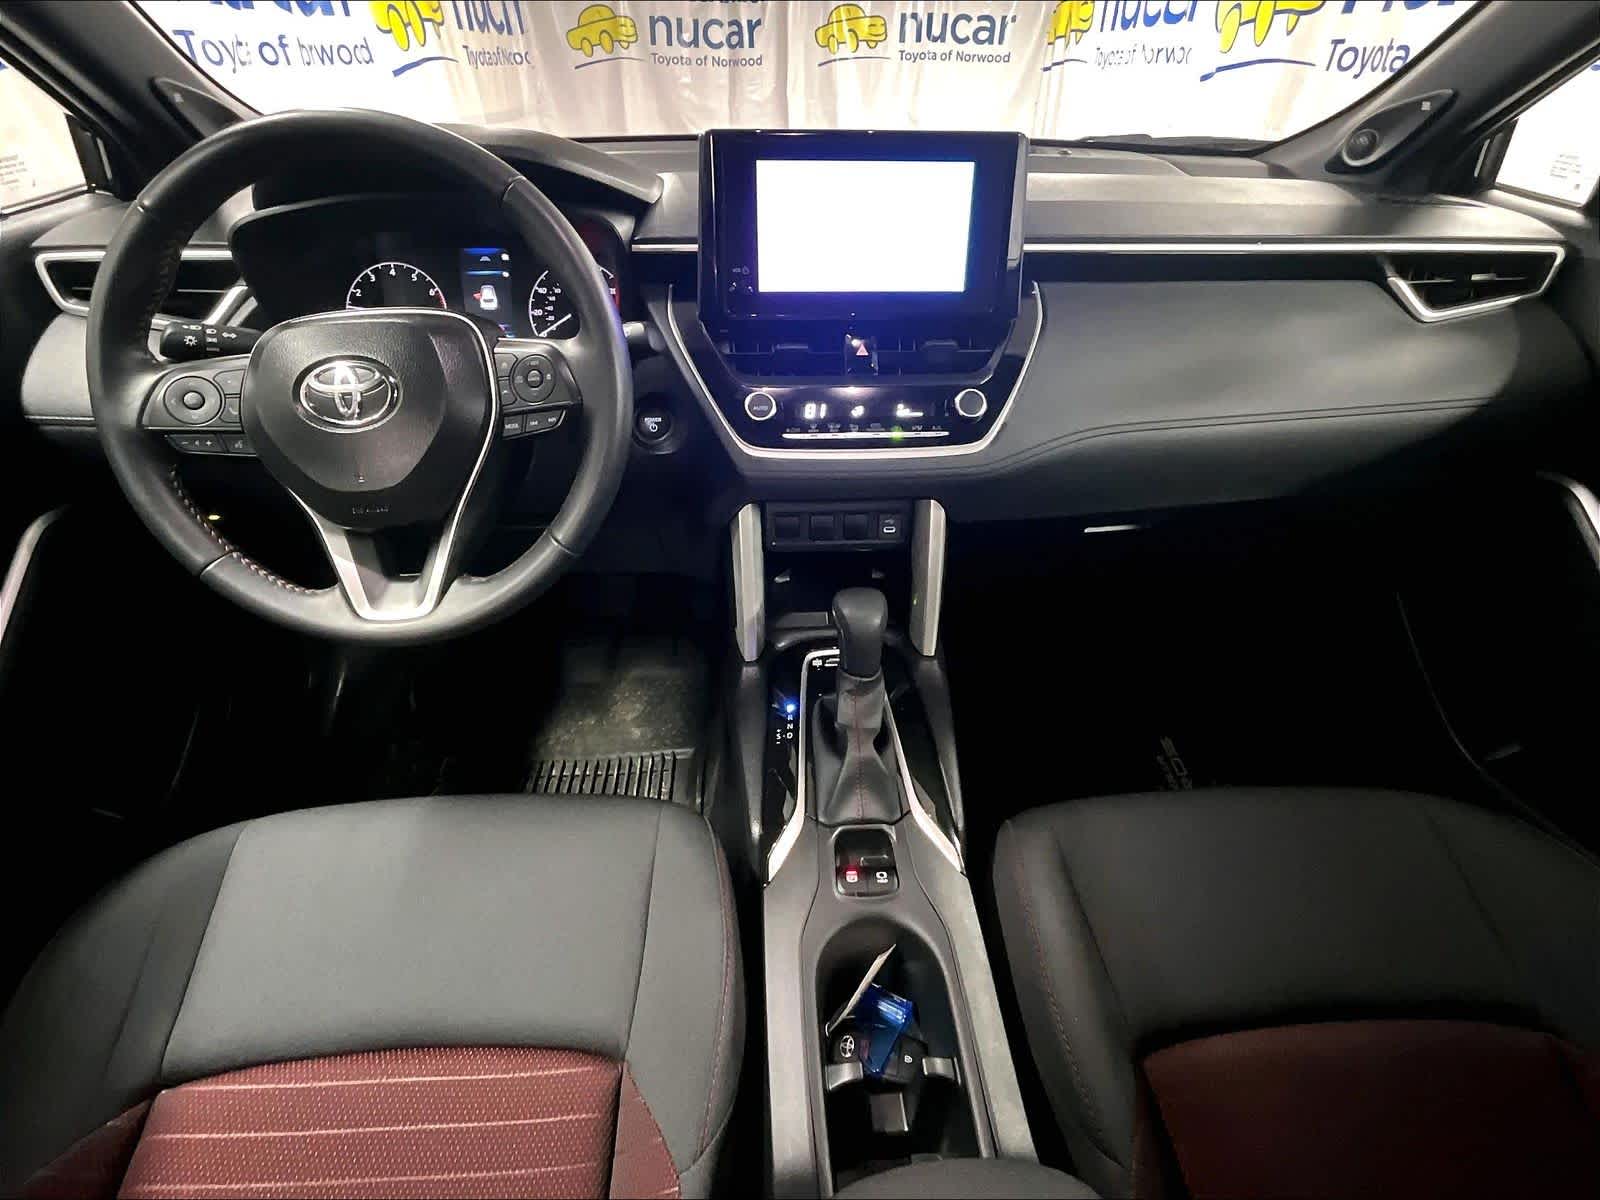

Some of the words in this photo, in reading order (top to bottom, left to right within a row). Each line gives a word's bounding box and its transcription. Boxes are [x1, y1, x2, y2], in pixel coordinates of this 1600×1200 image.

[648, 15, 762, 50] nucar
[898, 12, 1017, 46] nucar
[258, 34, 291, 66] of
[898, 49, 937, 64] Toyota
[940, 49, 953, 62] of
[955, 50, 1011, 64] Norwood
[650, 52, 692, 67] Toyota
[695, 55, 708, 67] of
[711, 55, 763, 68] Norwood
[1325, 38, 1411, 80] Toyota
[370, 274, 376, 282] 3
[389, 268, 396, 276] 4
[411, 273, 418, 281] 5
[355, 288, 362, 297] 2
